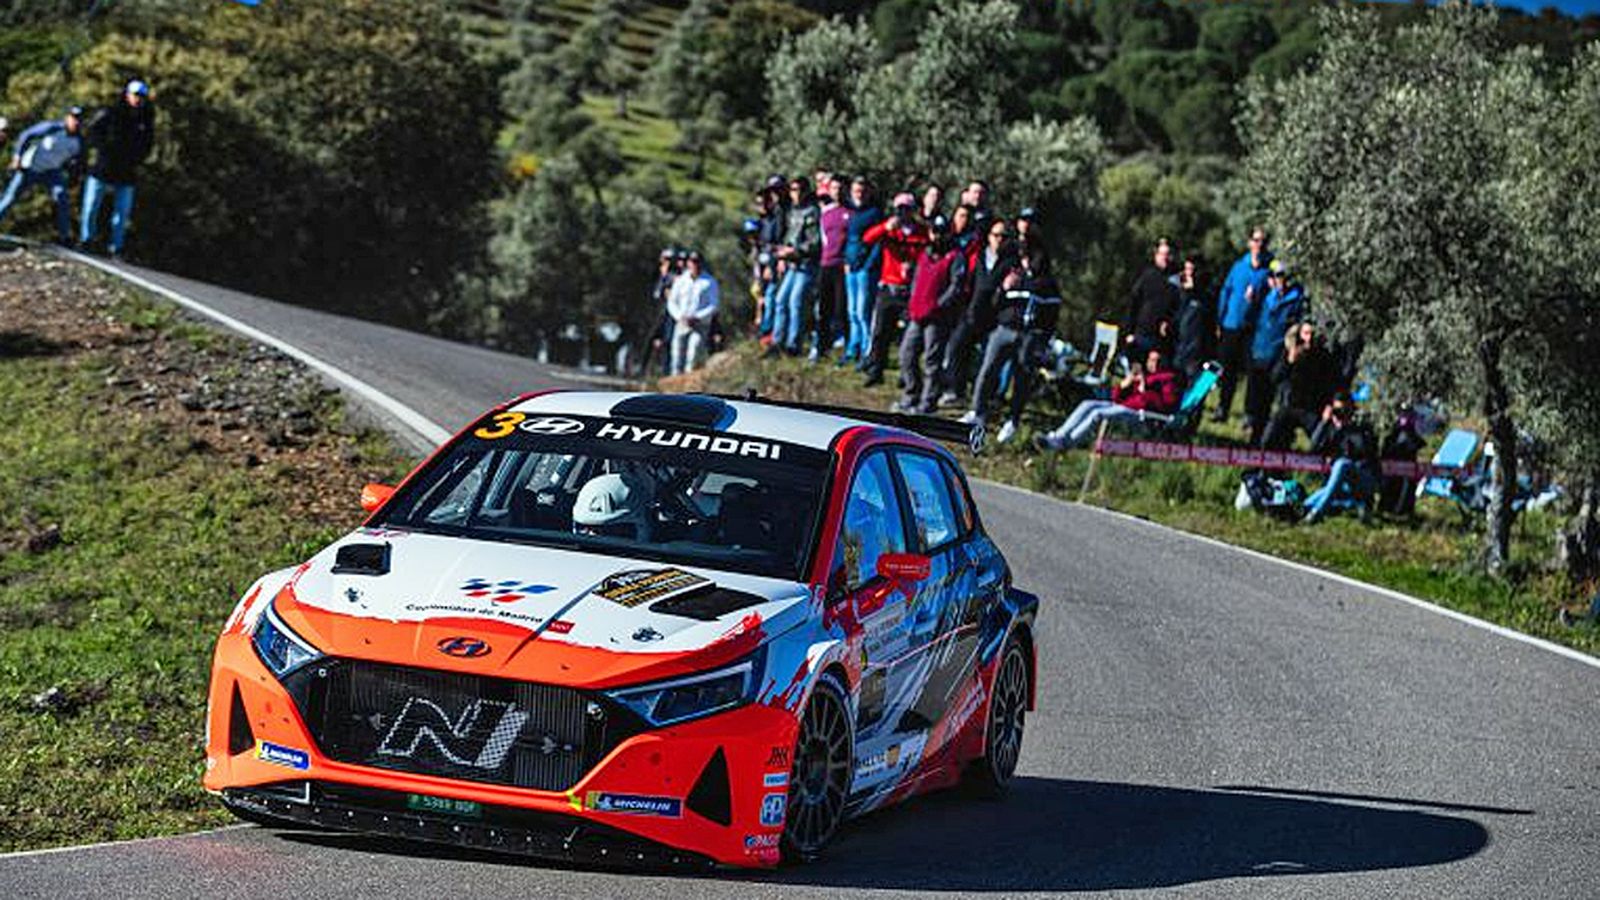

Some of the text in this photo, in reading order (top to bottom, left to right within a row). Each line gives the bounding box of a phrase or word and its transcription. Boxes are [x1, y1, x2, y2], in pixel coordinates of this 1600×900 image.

[474, 411, 782, 460] 3 HYUNDAI
[405, 603, 543, 623] Comunidad de Madrid
[613, 799, 672, 811] MICHELIN
